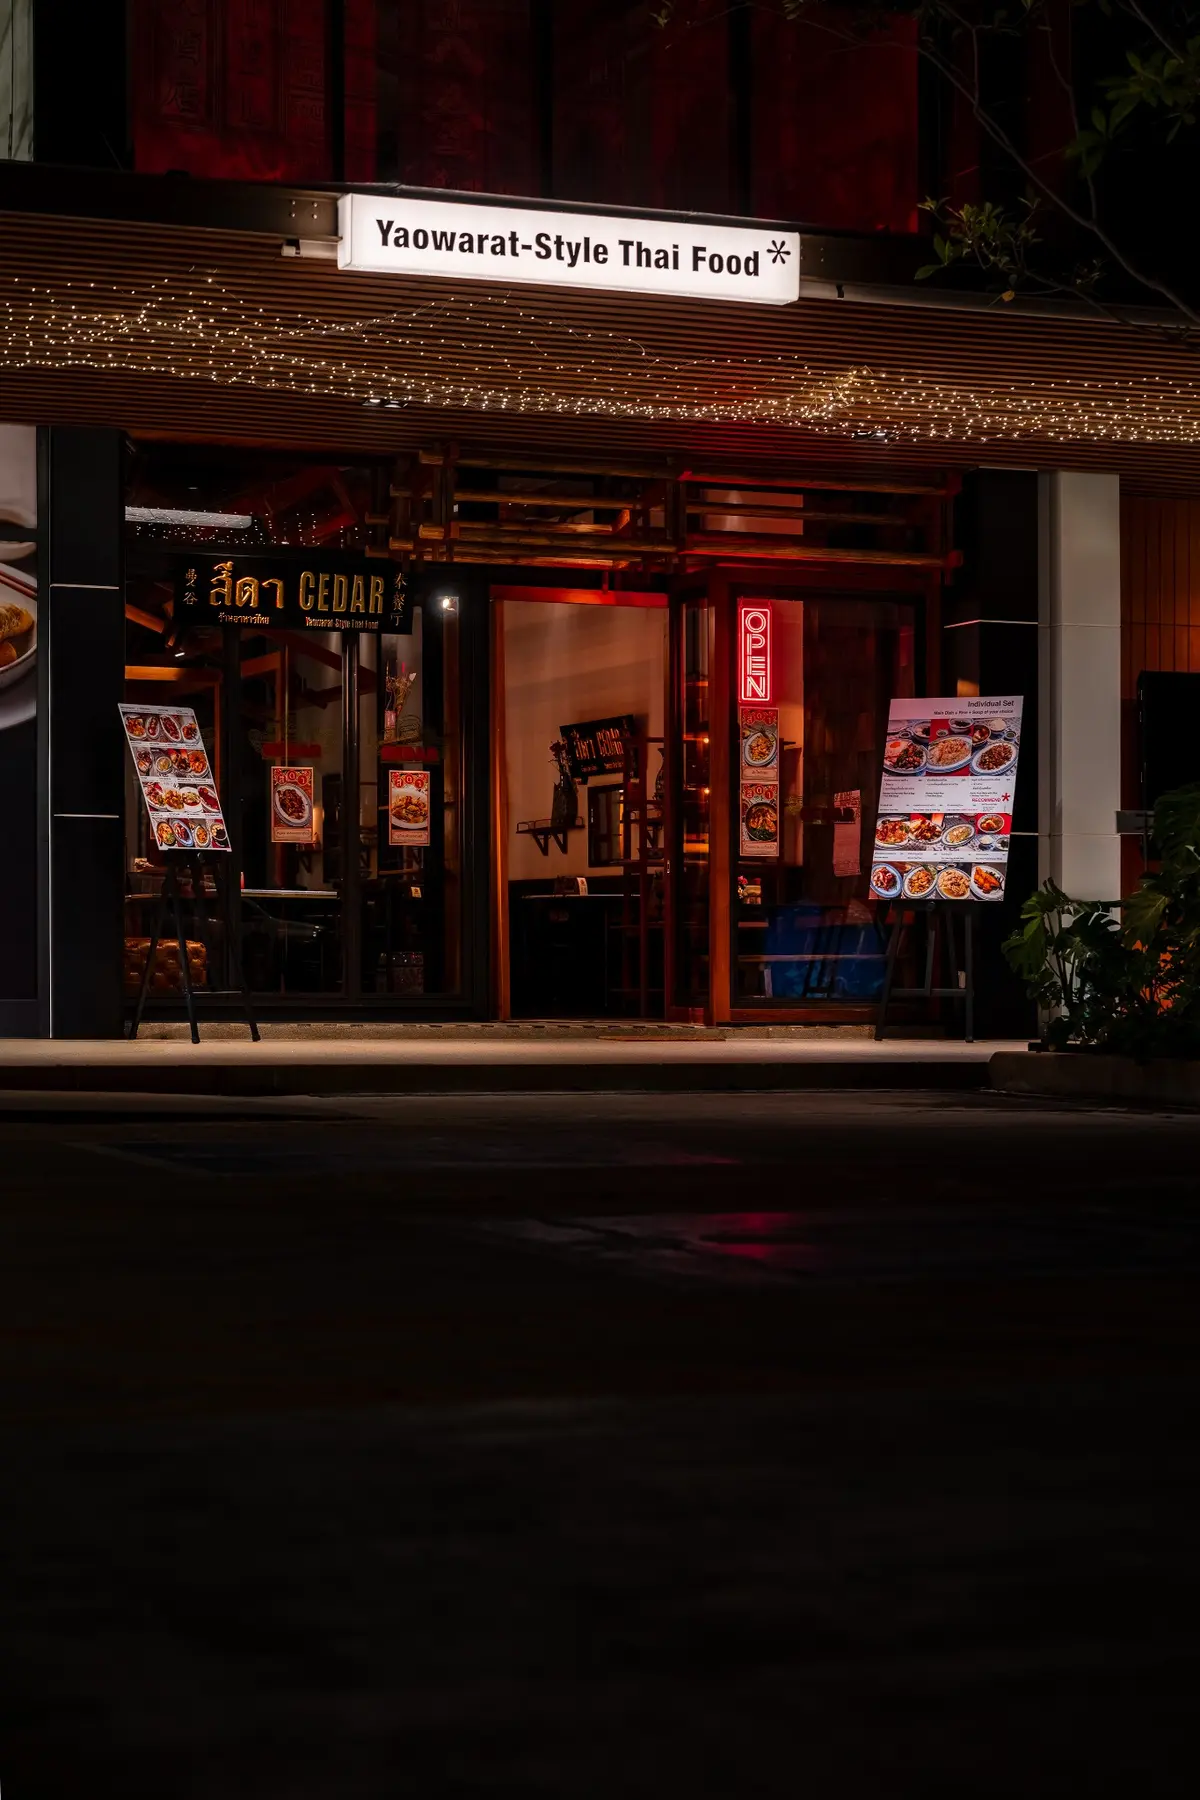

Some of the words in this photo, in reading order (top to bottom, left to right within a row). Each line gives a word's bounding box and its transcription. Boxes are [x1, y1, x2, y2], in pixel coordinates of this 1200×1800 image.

[375, 218, 609, 267] Yaowarat-Style
[618, 239, 679, 270] Thai
[208, 561, 285, 609] สีดา
[299, 570, 384, 614] CEDAR
[745, 611, 767, 698] OPEN
